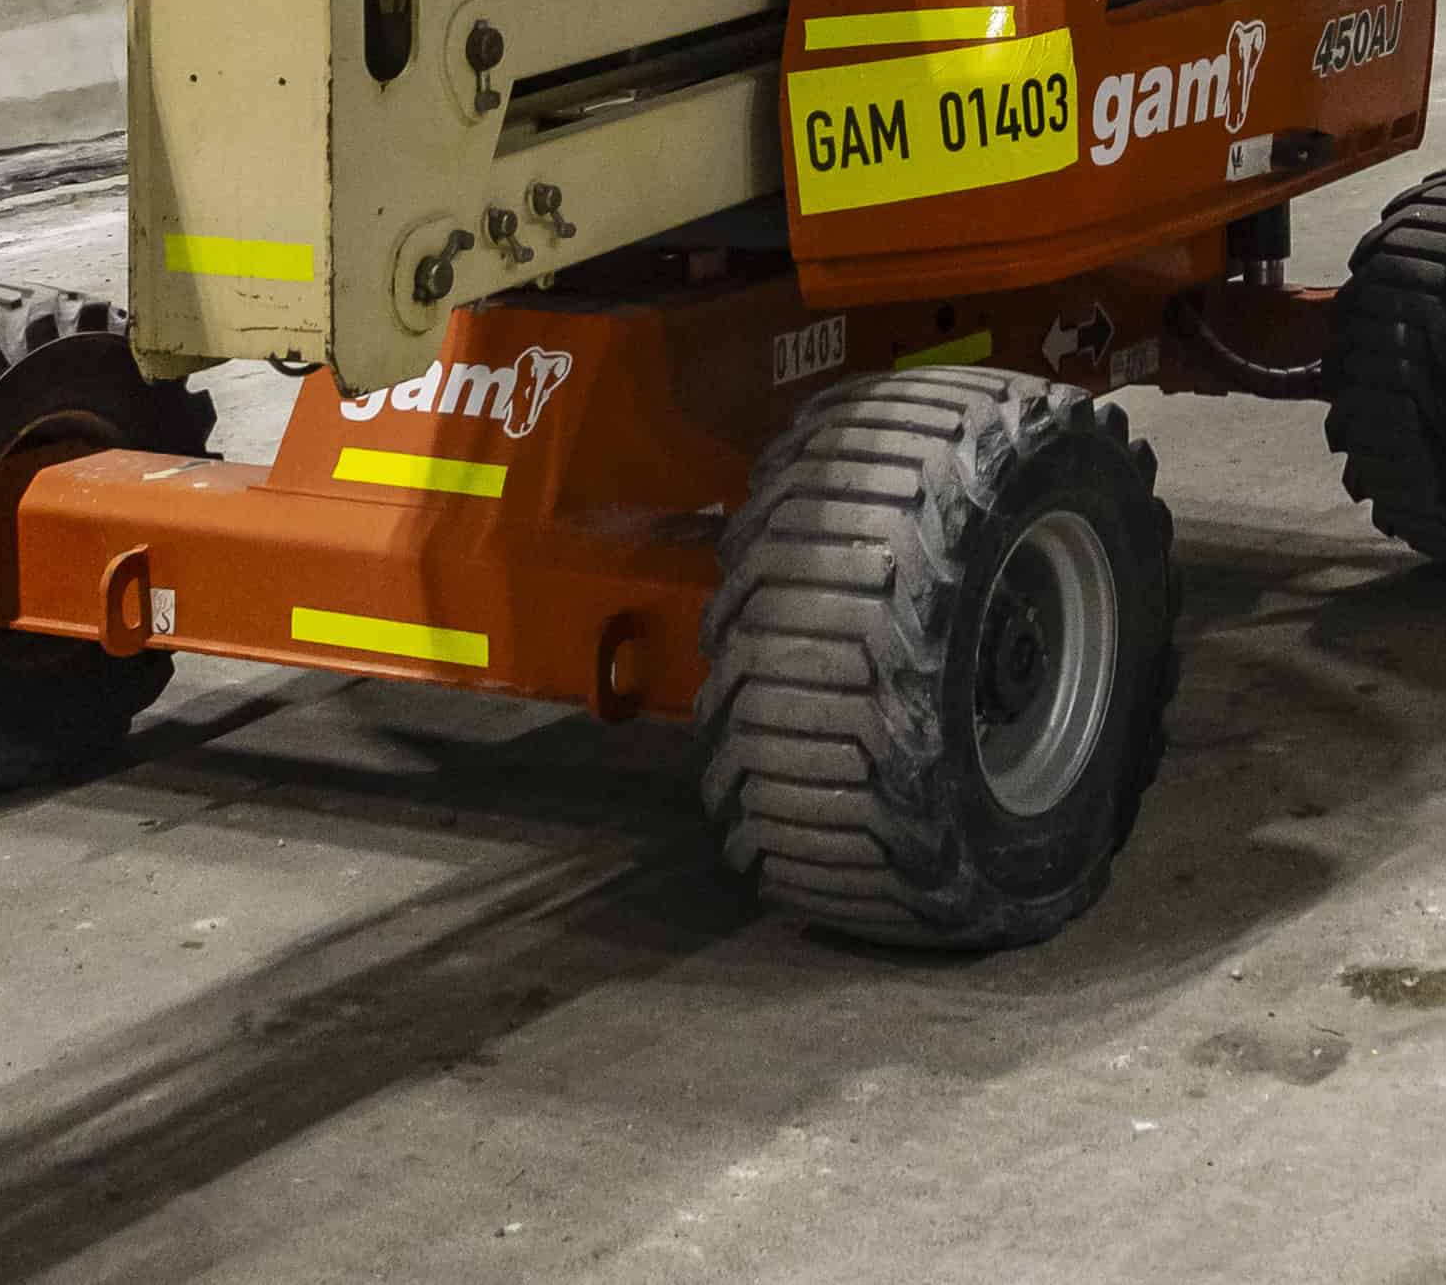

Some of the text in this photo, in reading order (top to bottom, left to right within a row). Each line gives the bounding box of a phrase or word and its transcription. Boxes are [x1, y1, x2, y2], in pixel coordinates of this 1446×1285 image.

[805, 72, 1069, 173] GAM 01403
[1090, 53, 1231, 166] gam
[776, 318, 843, 381] 01403
